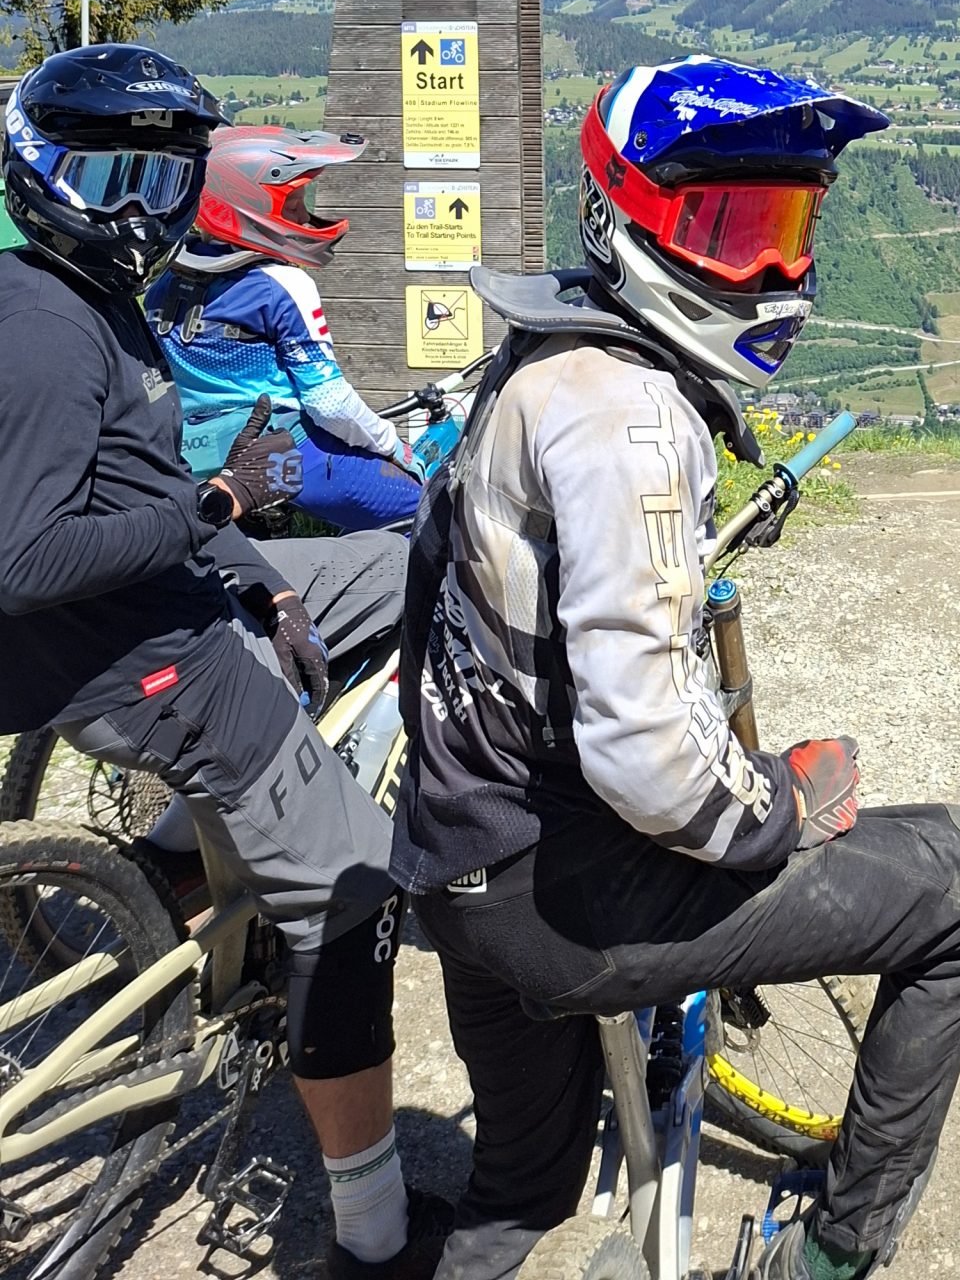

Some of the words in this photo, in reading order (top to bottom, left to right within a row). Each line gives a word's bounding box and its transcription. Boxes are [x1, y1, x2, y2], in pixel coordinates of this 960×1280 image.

[416, 72, 464, 90] Start
[406, 231, 415, 239] To
[416, 231, 429, 239] Trail
[430, 232, 455, 240] Starting
[374, 893, 398, 963] POC
